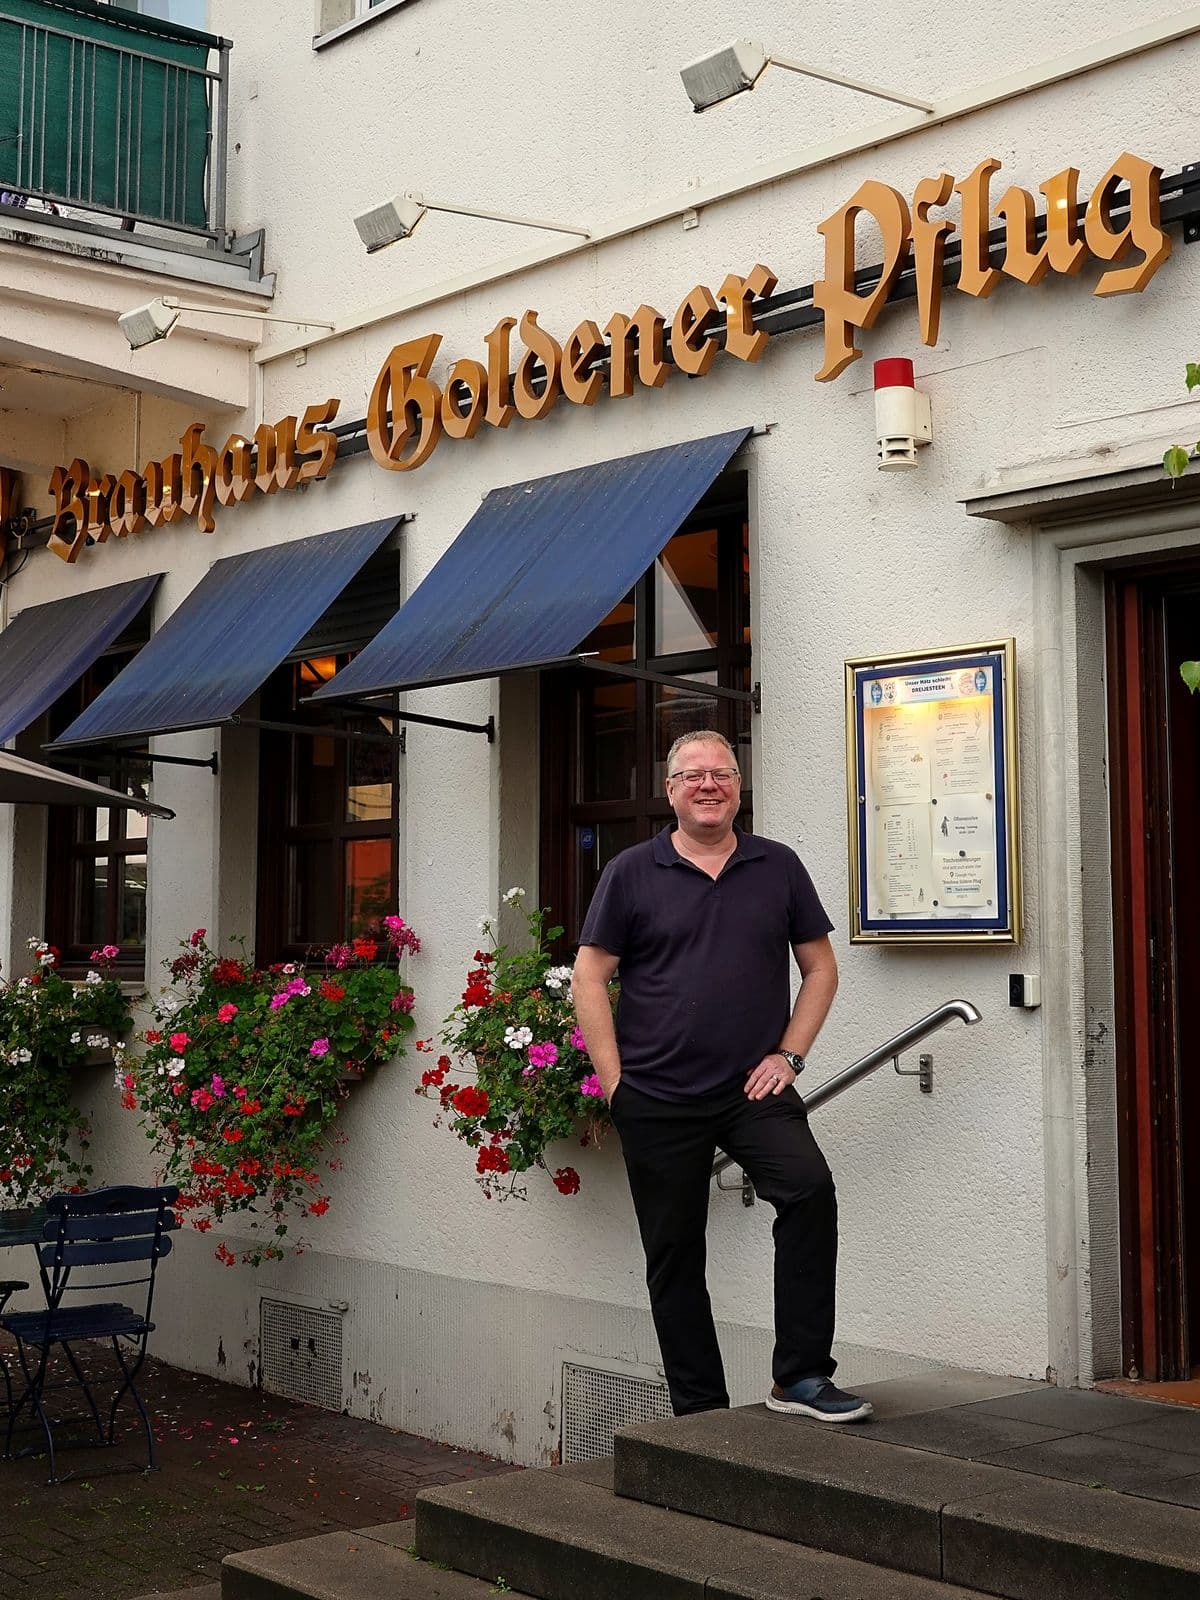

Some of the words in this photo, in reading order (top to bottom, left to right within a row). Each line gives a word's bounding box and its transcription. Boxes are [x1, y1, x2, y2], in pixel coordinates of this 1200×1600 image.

[47, 398, 341, 563] Brauhaus
[366, 263, 778, 472] Goldener
[813, 152, 1172, 382] Pflug
